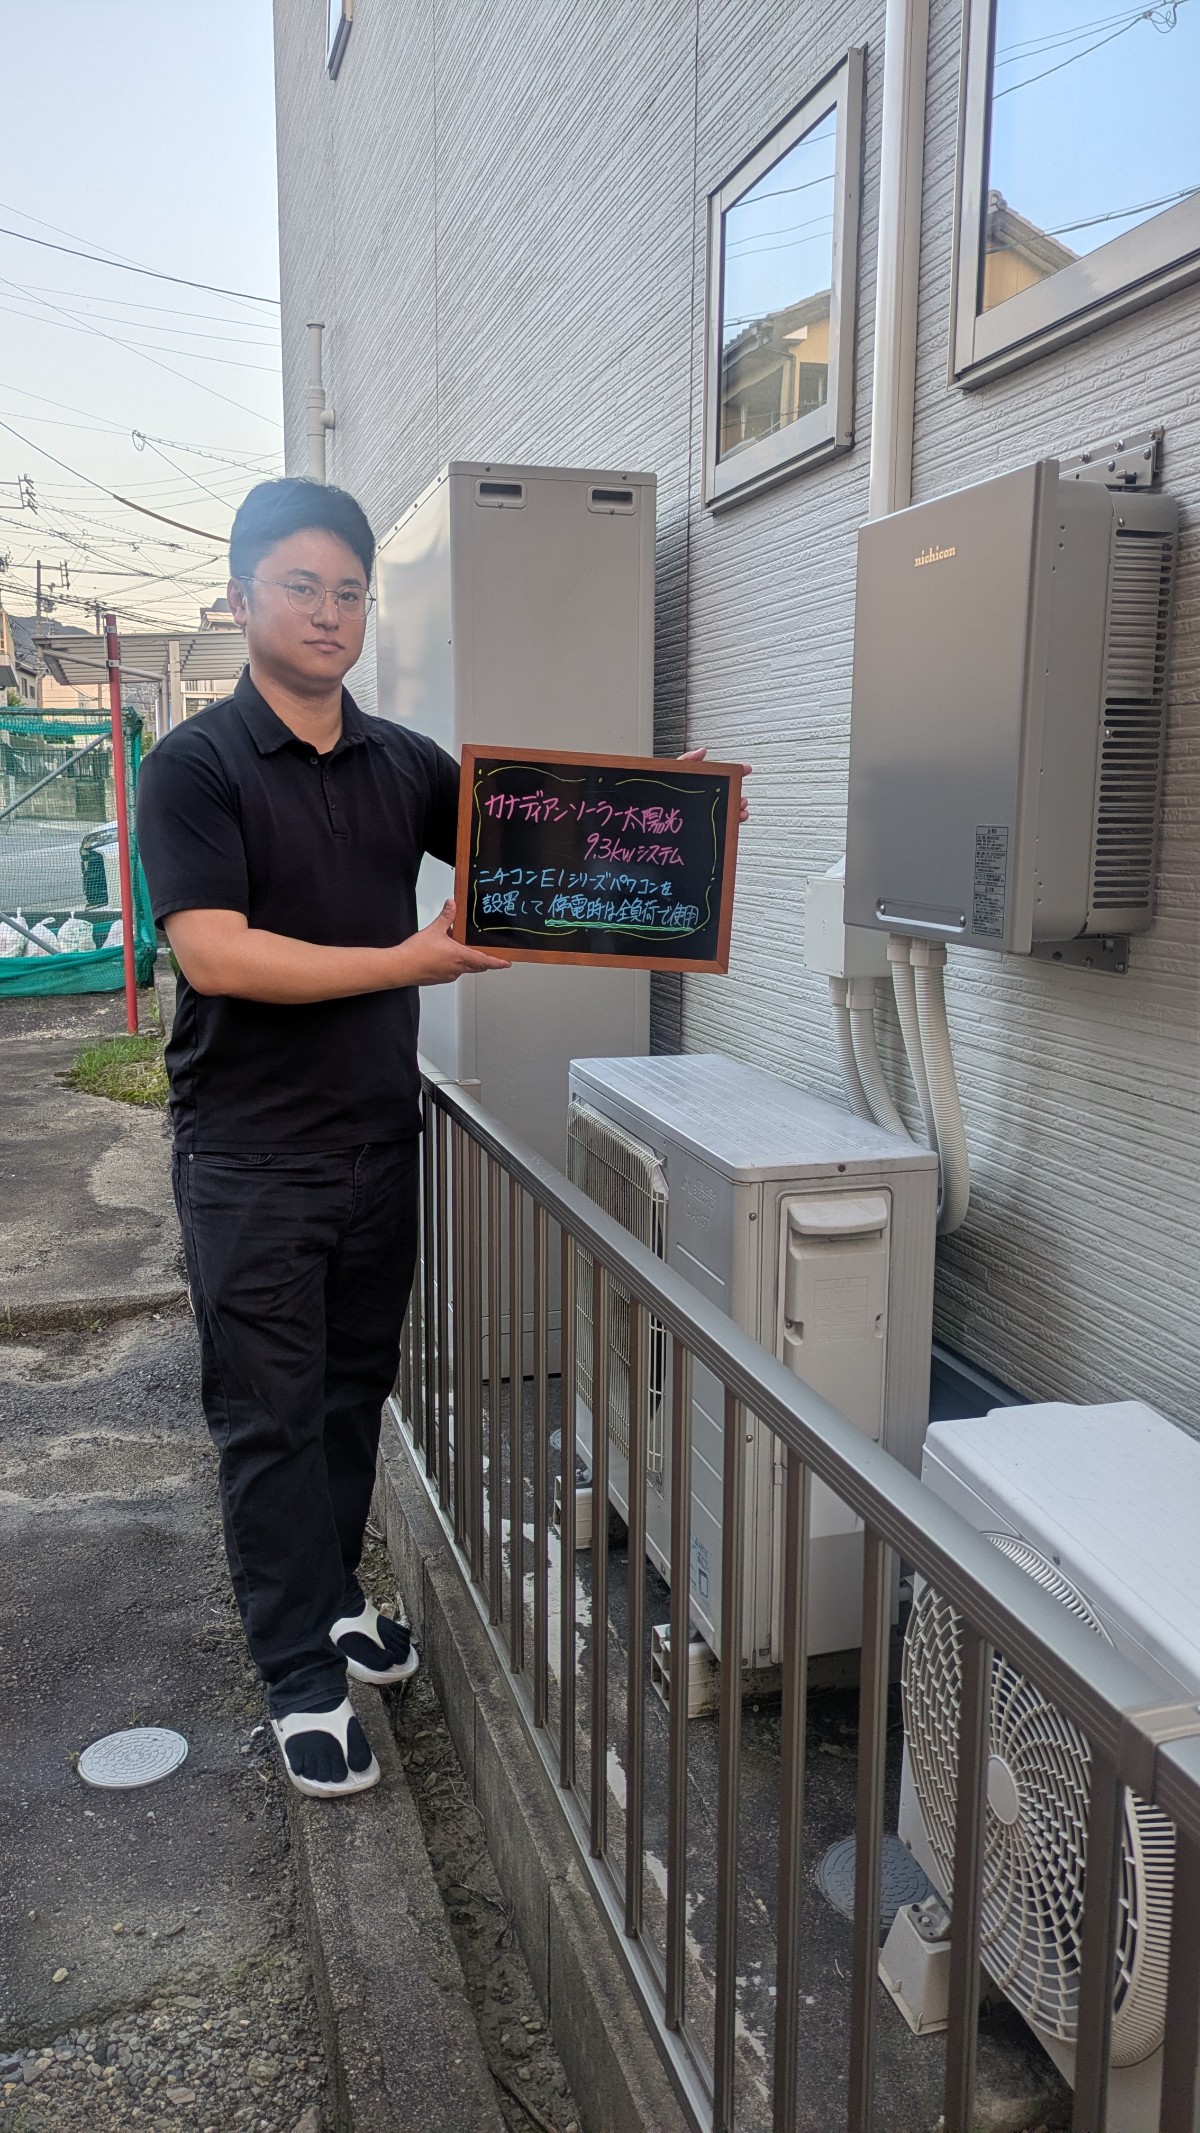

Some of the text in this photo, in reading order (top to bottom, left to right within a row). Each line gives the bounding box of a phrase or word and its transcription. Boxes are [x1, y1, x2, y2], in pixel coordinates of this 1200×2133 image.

[914, 545, 956, 567] nichicon
[485, 790, 683, 834] カナディアンソーラー太陽光
